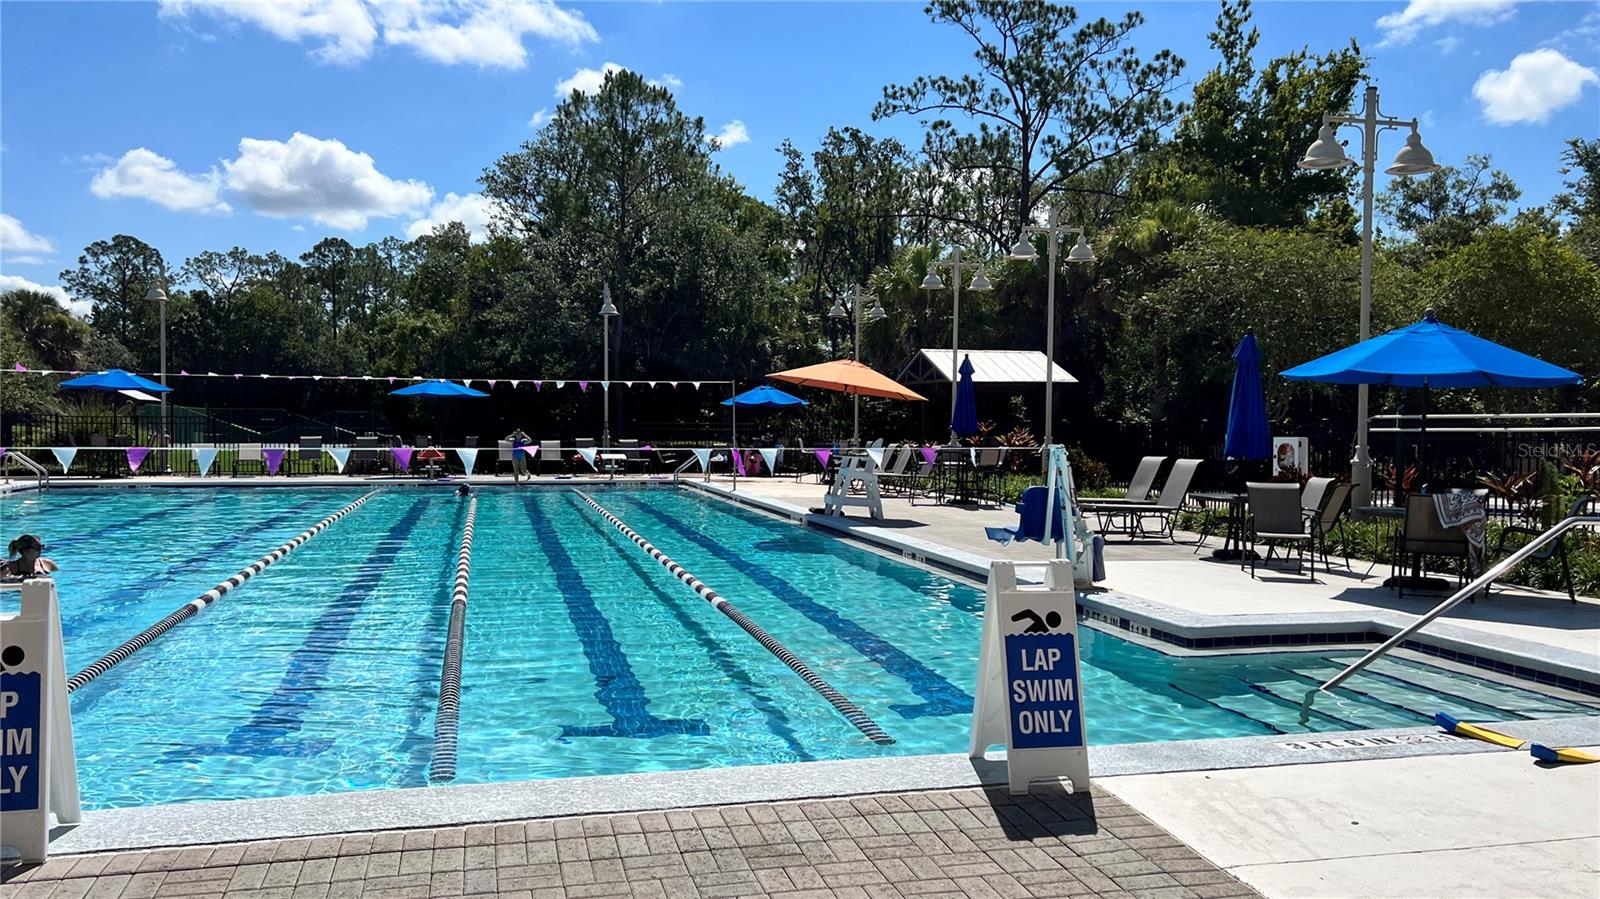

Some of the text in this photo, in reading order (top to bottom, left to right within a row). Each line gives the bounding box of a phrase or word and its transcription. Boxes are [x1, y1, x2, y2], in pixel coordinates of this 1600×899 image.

[1021, 648, 1061, 671] LAP
[1013, 678, 1074, 703] SWIM
[1019, 709, 1073, 734] ONLY
